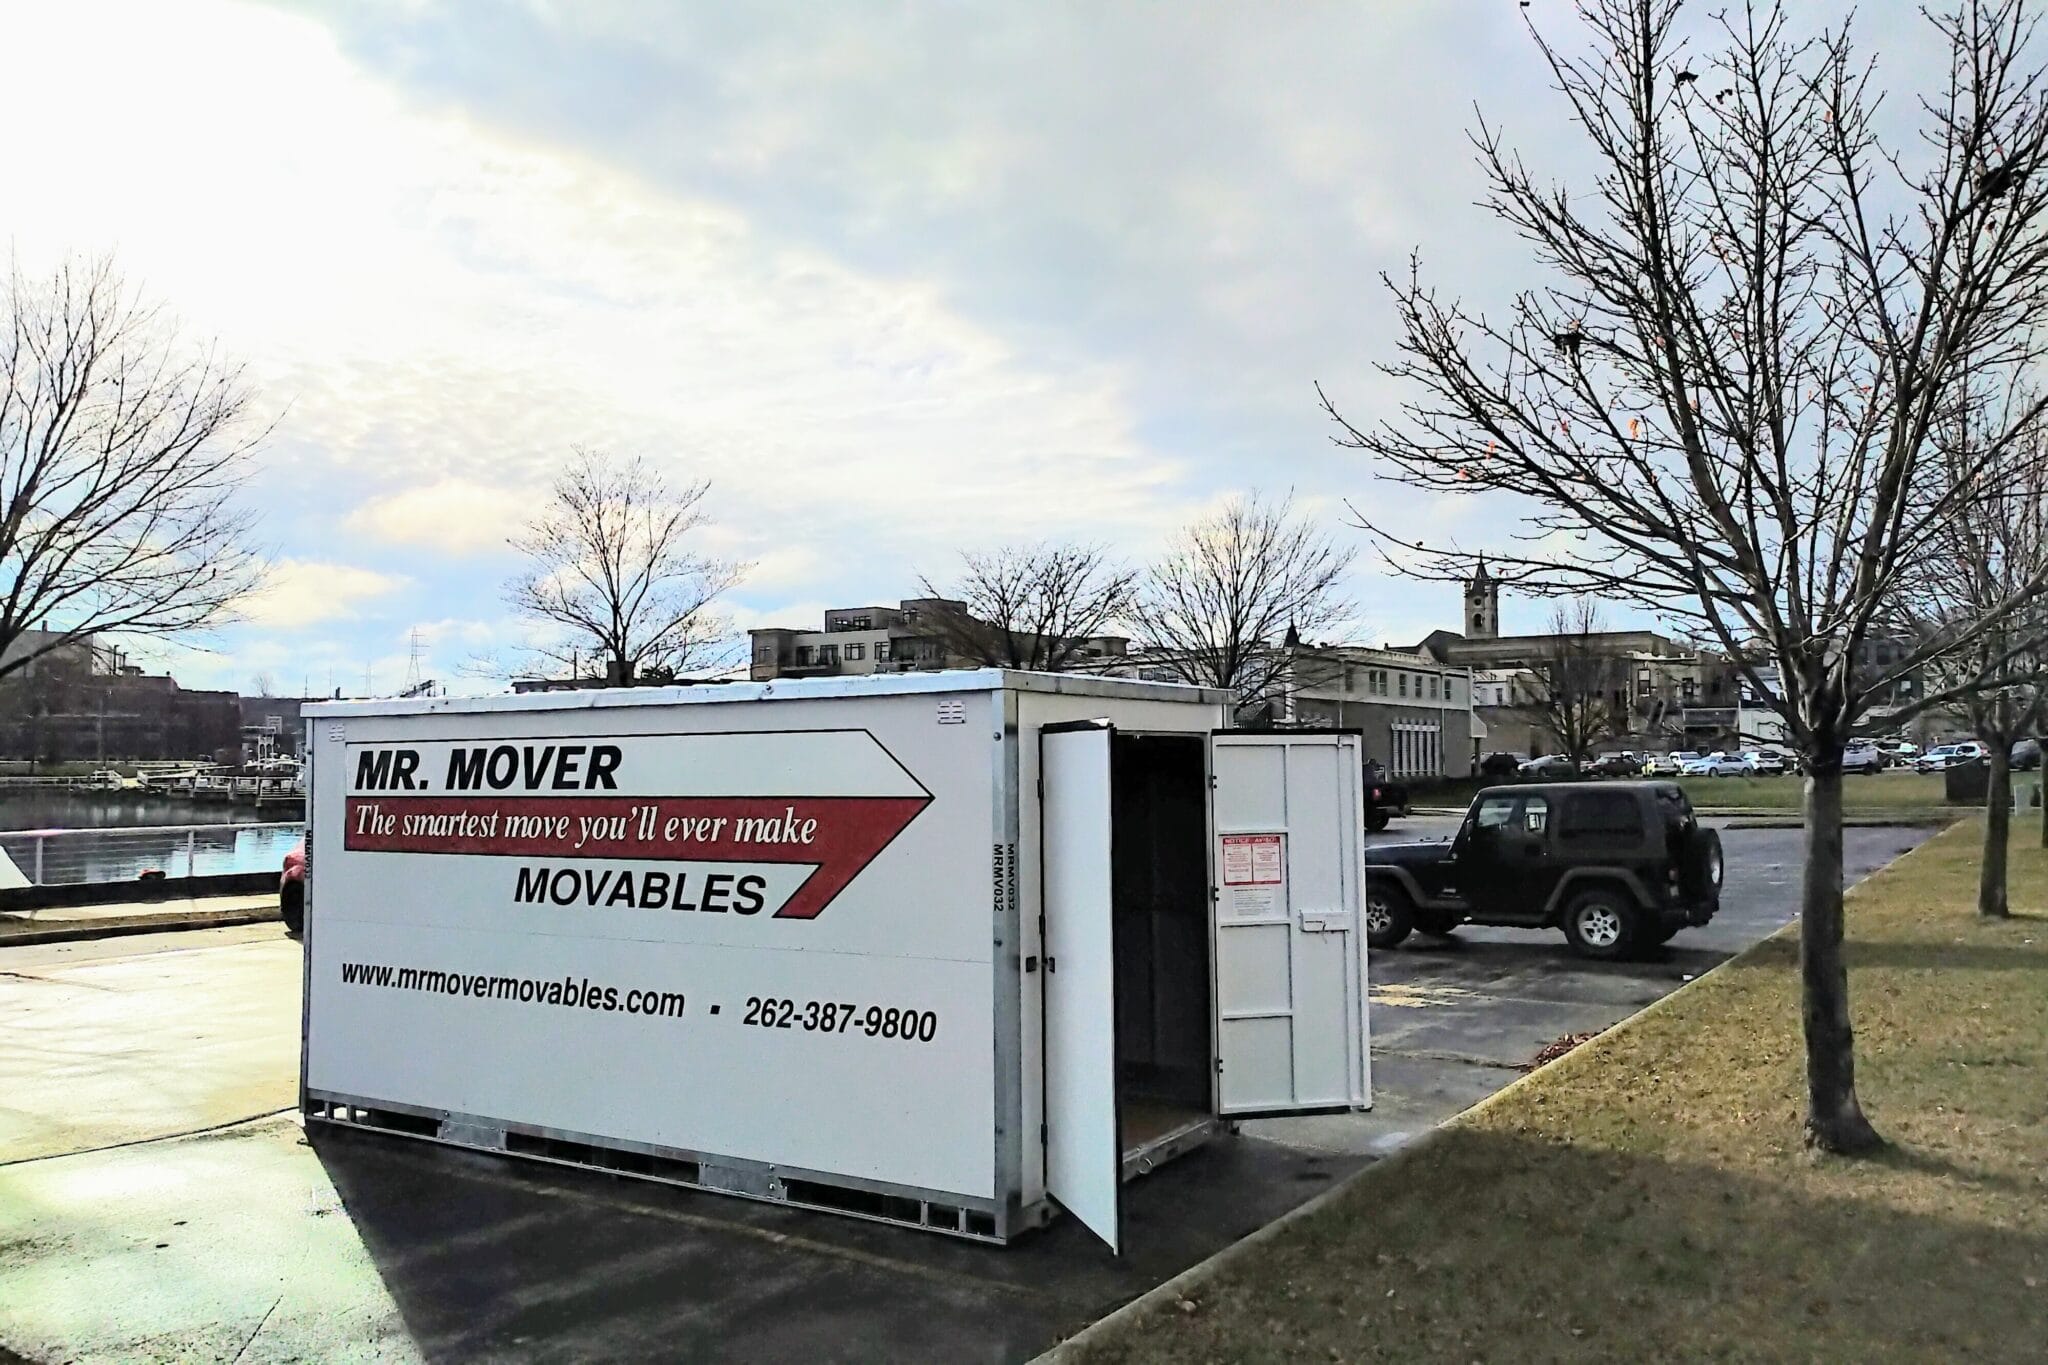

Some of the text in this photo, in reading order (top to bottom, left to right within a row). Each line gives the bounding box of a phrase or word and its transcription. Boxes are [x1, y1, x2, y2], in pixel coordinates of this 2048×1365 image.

[355, 745, 623, 790] MR. MOVER
[356, 804, 818, 849] The smartest move you'll ever make
[514, 867, 767, 916] MOVABLES
[993, 844, 1004, 912] MRMV032
[1007, 843, 1015, 911] MRMV032
[342, 962, 938, 1042] www.mrmovermovables.com 262-387-9800
